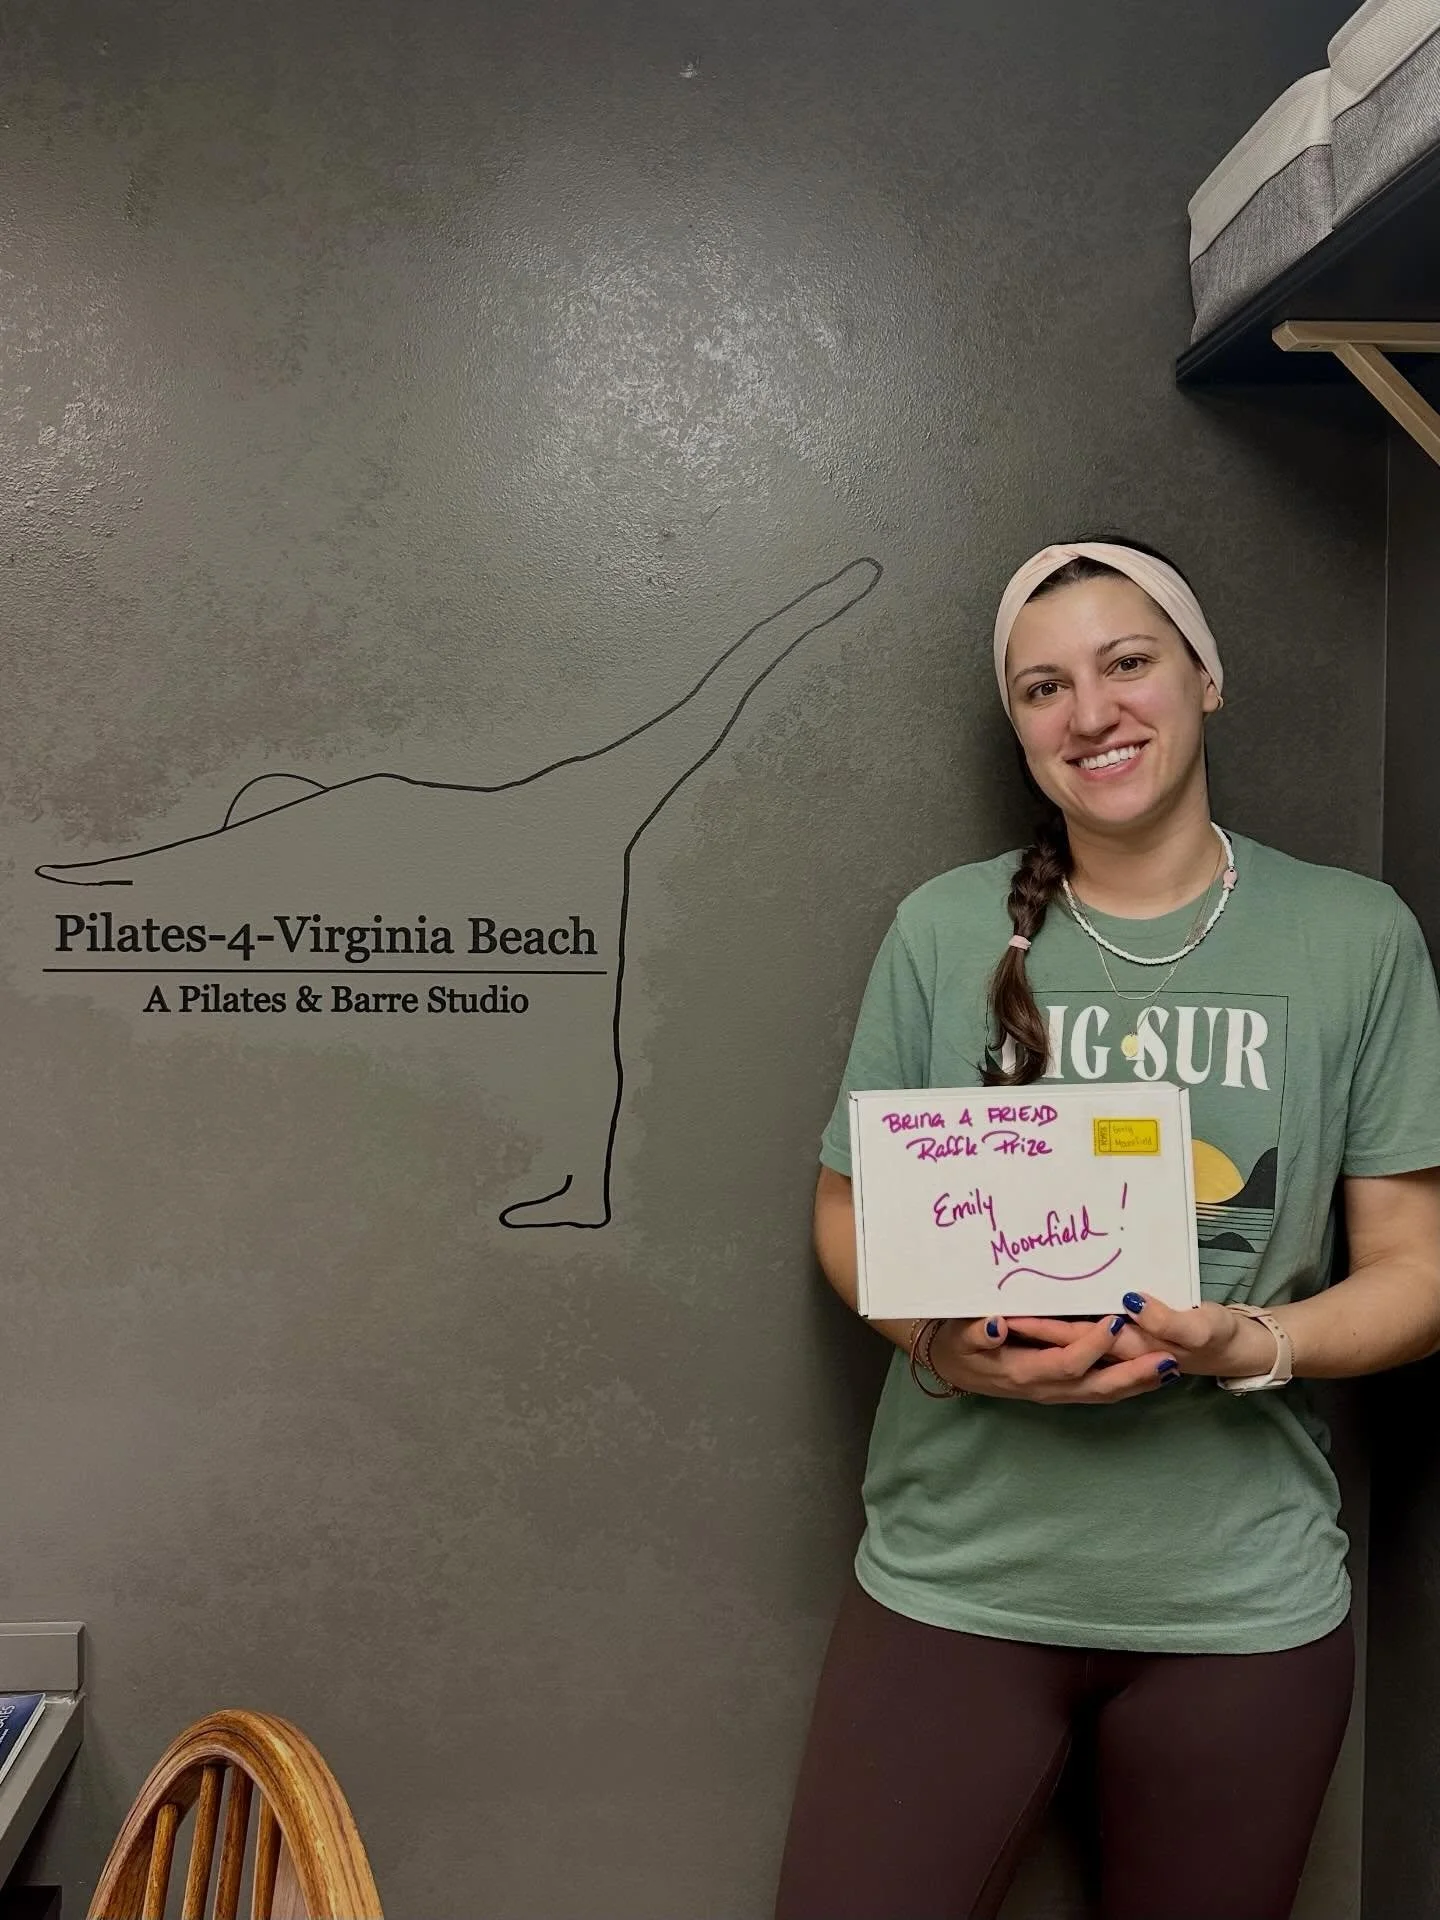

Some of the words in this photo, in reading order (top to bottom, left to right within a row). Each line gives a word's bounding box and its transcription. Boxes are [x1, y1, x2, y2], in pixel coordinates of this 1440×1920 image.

[54, 911, 456, 964] Pilates-4-Virginia
[467, 915, 599, 956] Beach
[142, 984, 172, 1014] A
[178, 983, 287, 1014] Pilates
[295, 984, 323, 1014] &
[330, 985, 420, 1014] Barre
[427, 984, 530, 1014] Studio
[1000, 1004, 1112, 1081] IG
[1131, 1004, 1271, 1091] SUR
[958, 1107, 974, 1127] A
[986, 1104, 1058, 1127] FRIEND
[905, 1135, 978, 1163] Raffle
[981, 1129, 1053, 1157] Prize
[932, 1187, 998, 1231] Emily
[990, 1205, 1109, 1266] Moorefield
